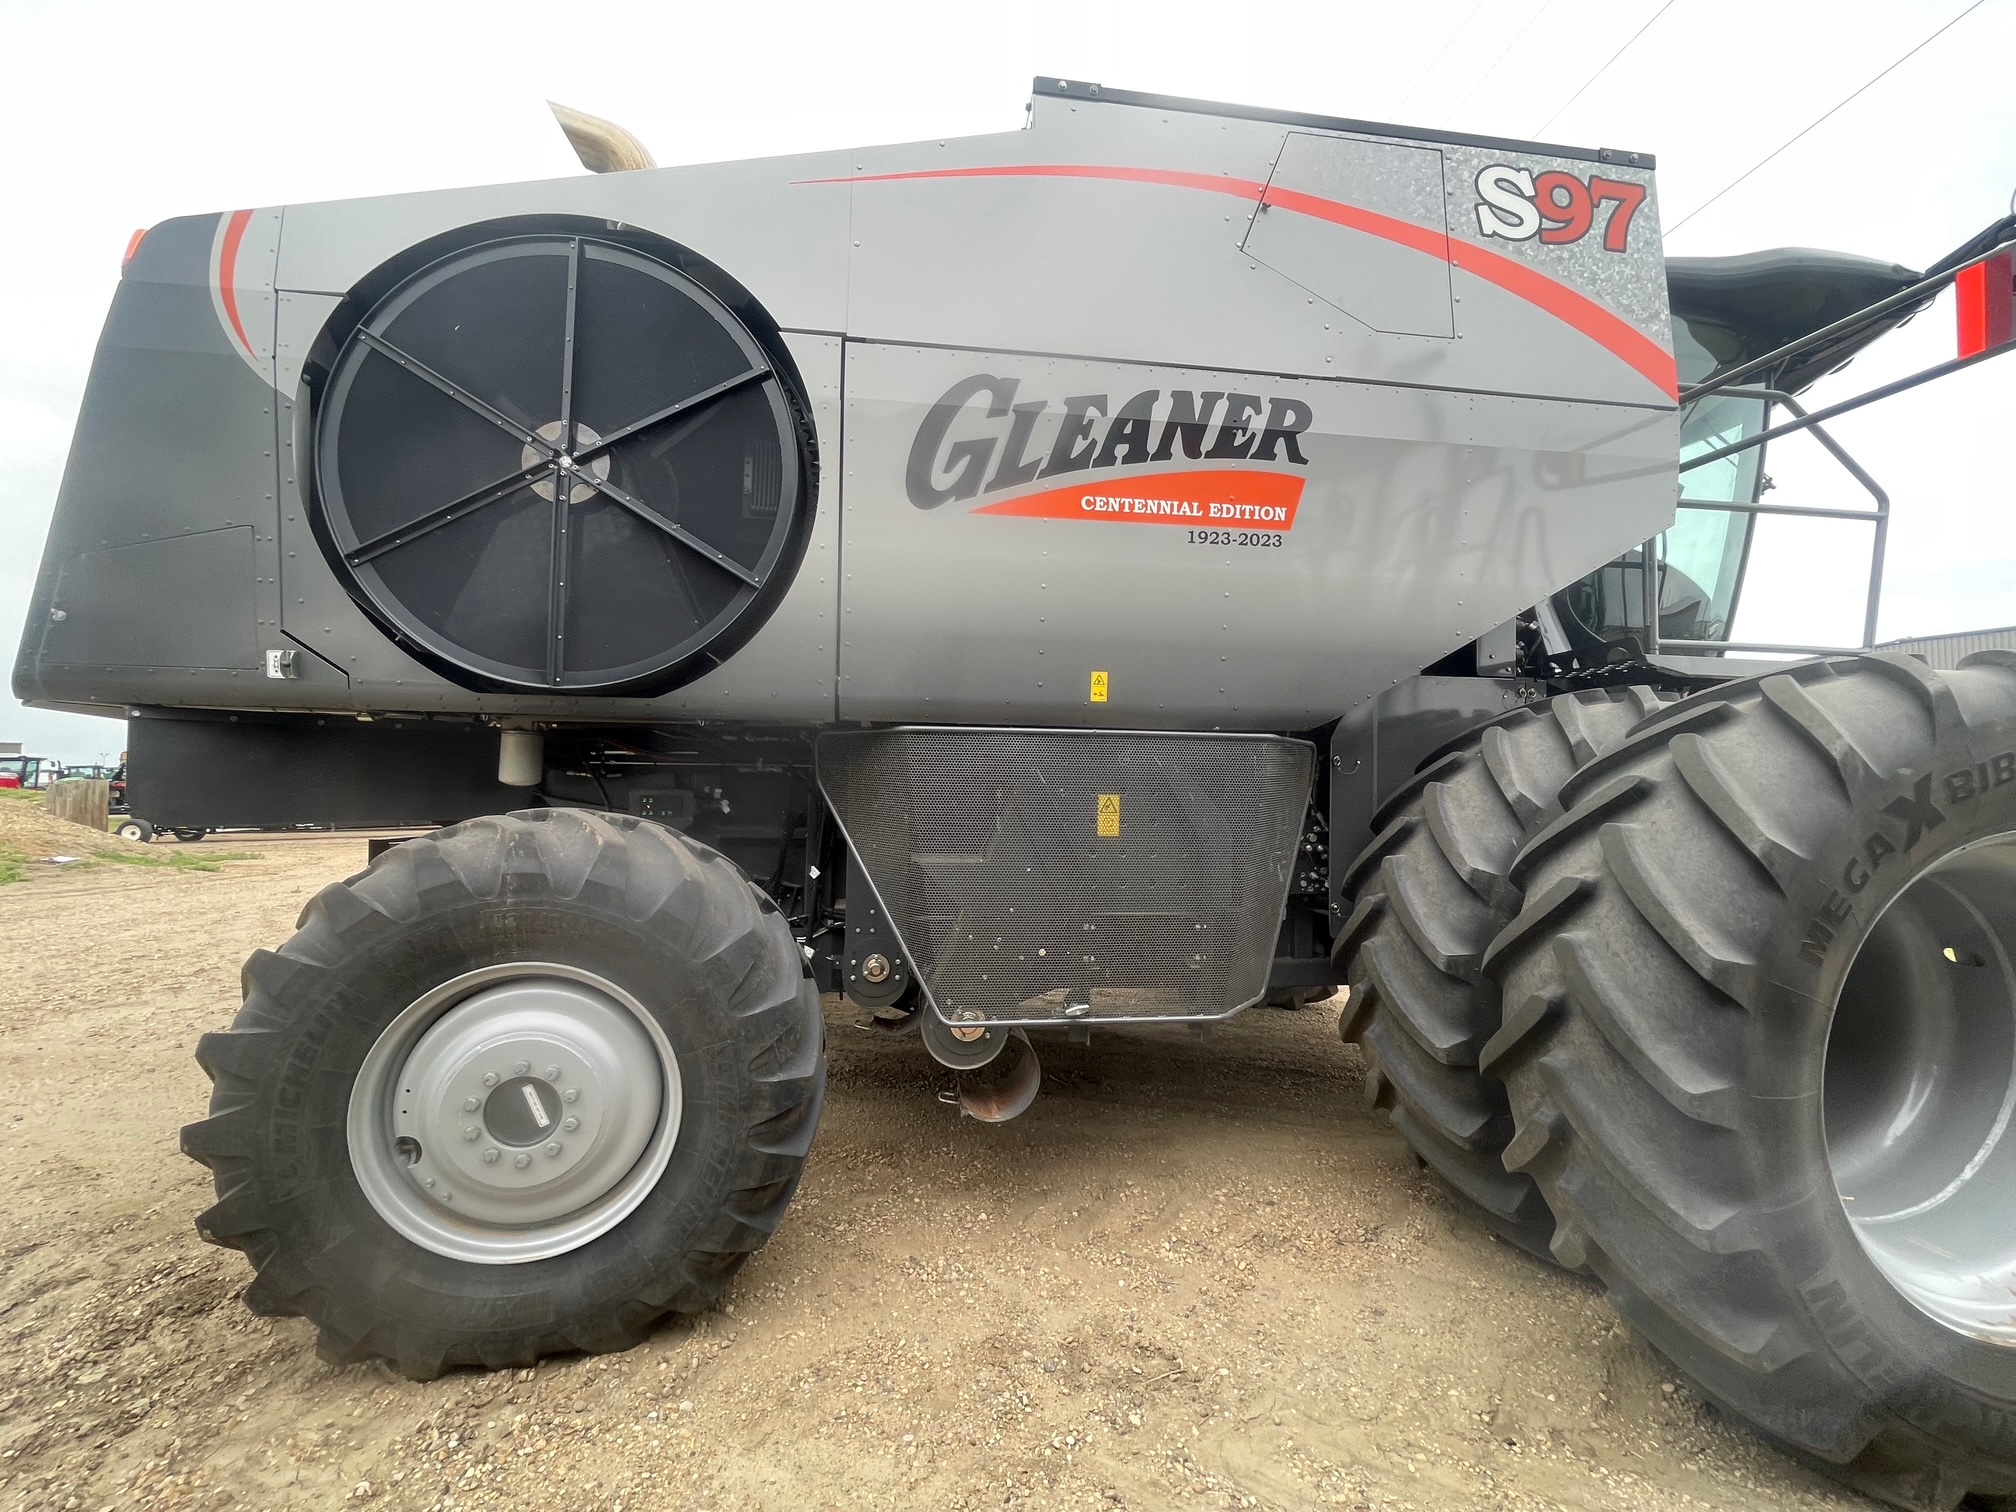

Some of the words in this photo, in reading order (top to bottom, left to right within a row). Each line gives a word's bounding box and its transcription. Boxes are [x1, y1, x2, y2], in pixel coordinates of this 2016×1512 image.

[1475, 163, 1647, 254] S97
[905, 373, 1314, 511] GLEANER
[1080, 495, 1203, 517] CENTENNIAL
[1208, 503, 1287, 521] EDITION
[1187, 530, 1283, 548] 1923-2023
